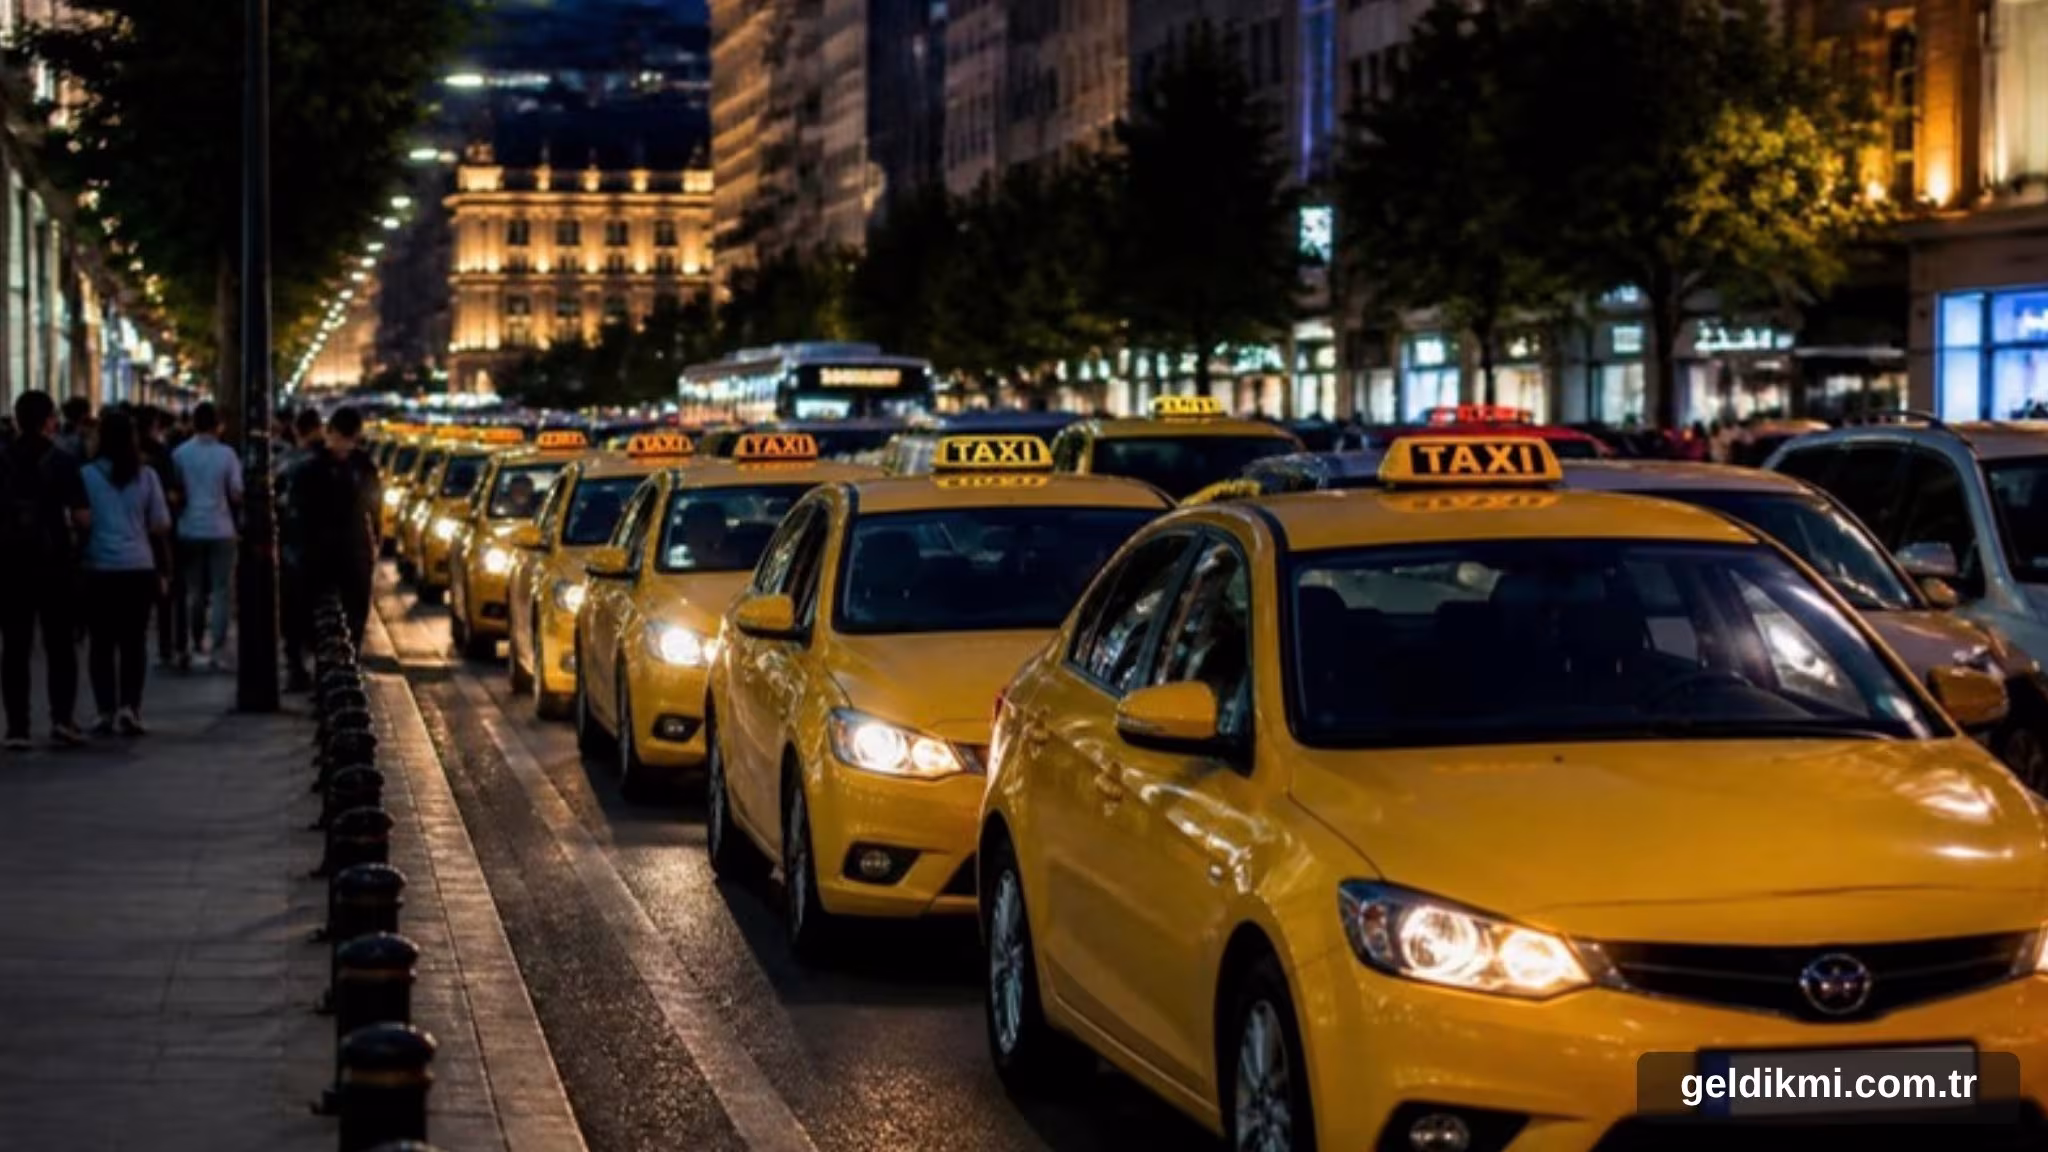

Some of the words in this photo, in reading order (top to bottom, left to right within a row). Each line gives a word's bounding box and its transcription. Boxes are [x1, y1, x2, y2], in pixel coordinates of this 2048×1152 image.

[751, 435, 804, 453] TAXI
[952, 441, 1031, 462] TAXI
[1418, 445, 1535, 473] TAXI
